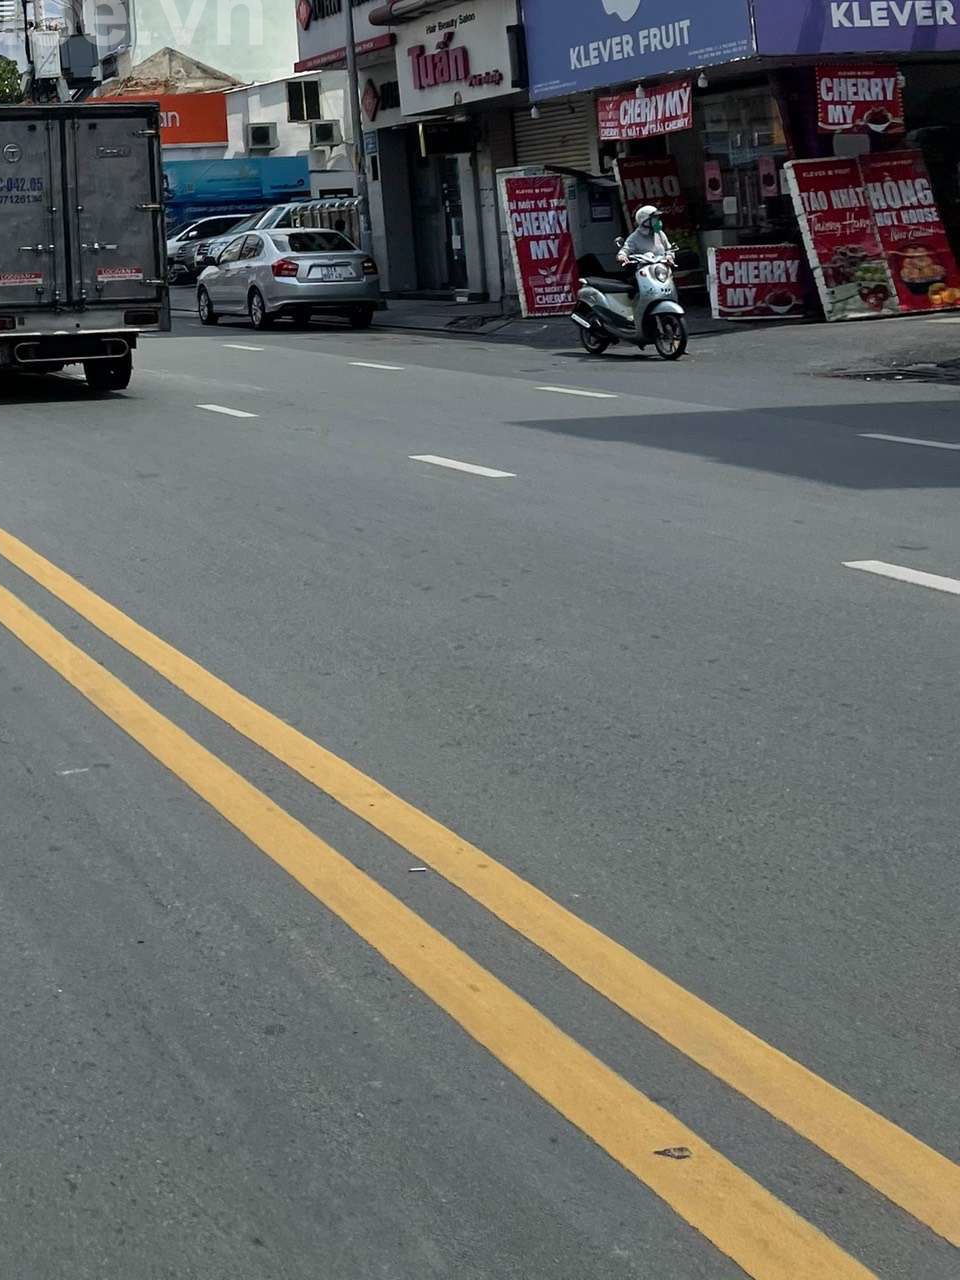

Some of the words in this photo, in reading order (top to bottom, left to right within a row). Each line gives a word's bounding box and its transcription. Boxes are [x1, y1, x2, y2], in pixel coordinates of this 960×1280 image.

[437, 18, 458, 32] Beauty
[458, 13, 476, 25] Salon
[830, 0, 957, 28] KLEVER
[569, 33, 635, 71] KLEVER
[638, 19, 691, 55] FRUIT
[407, 31, 470, 90] Tuấn
[820, 77, 897, 102] CHERRY
[619, 94, 665, 126] CHERRY
[827, 101, 856, 123] MỸ
[624, 175, 681, 200] NHO
[799, 188, 829, 211] TÁO
[866, 172, 935, 210] HỒNG
[511, 210, 569, 238] CHERRY
[530, 235, 560, 261] MỸ
[720, 260, 800, 285] CHERRY
[535, 293, 573, 305] CHERRY
[726, 284, 757, 307] MỸ
